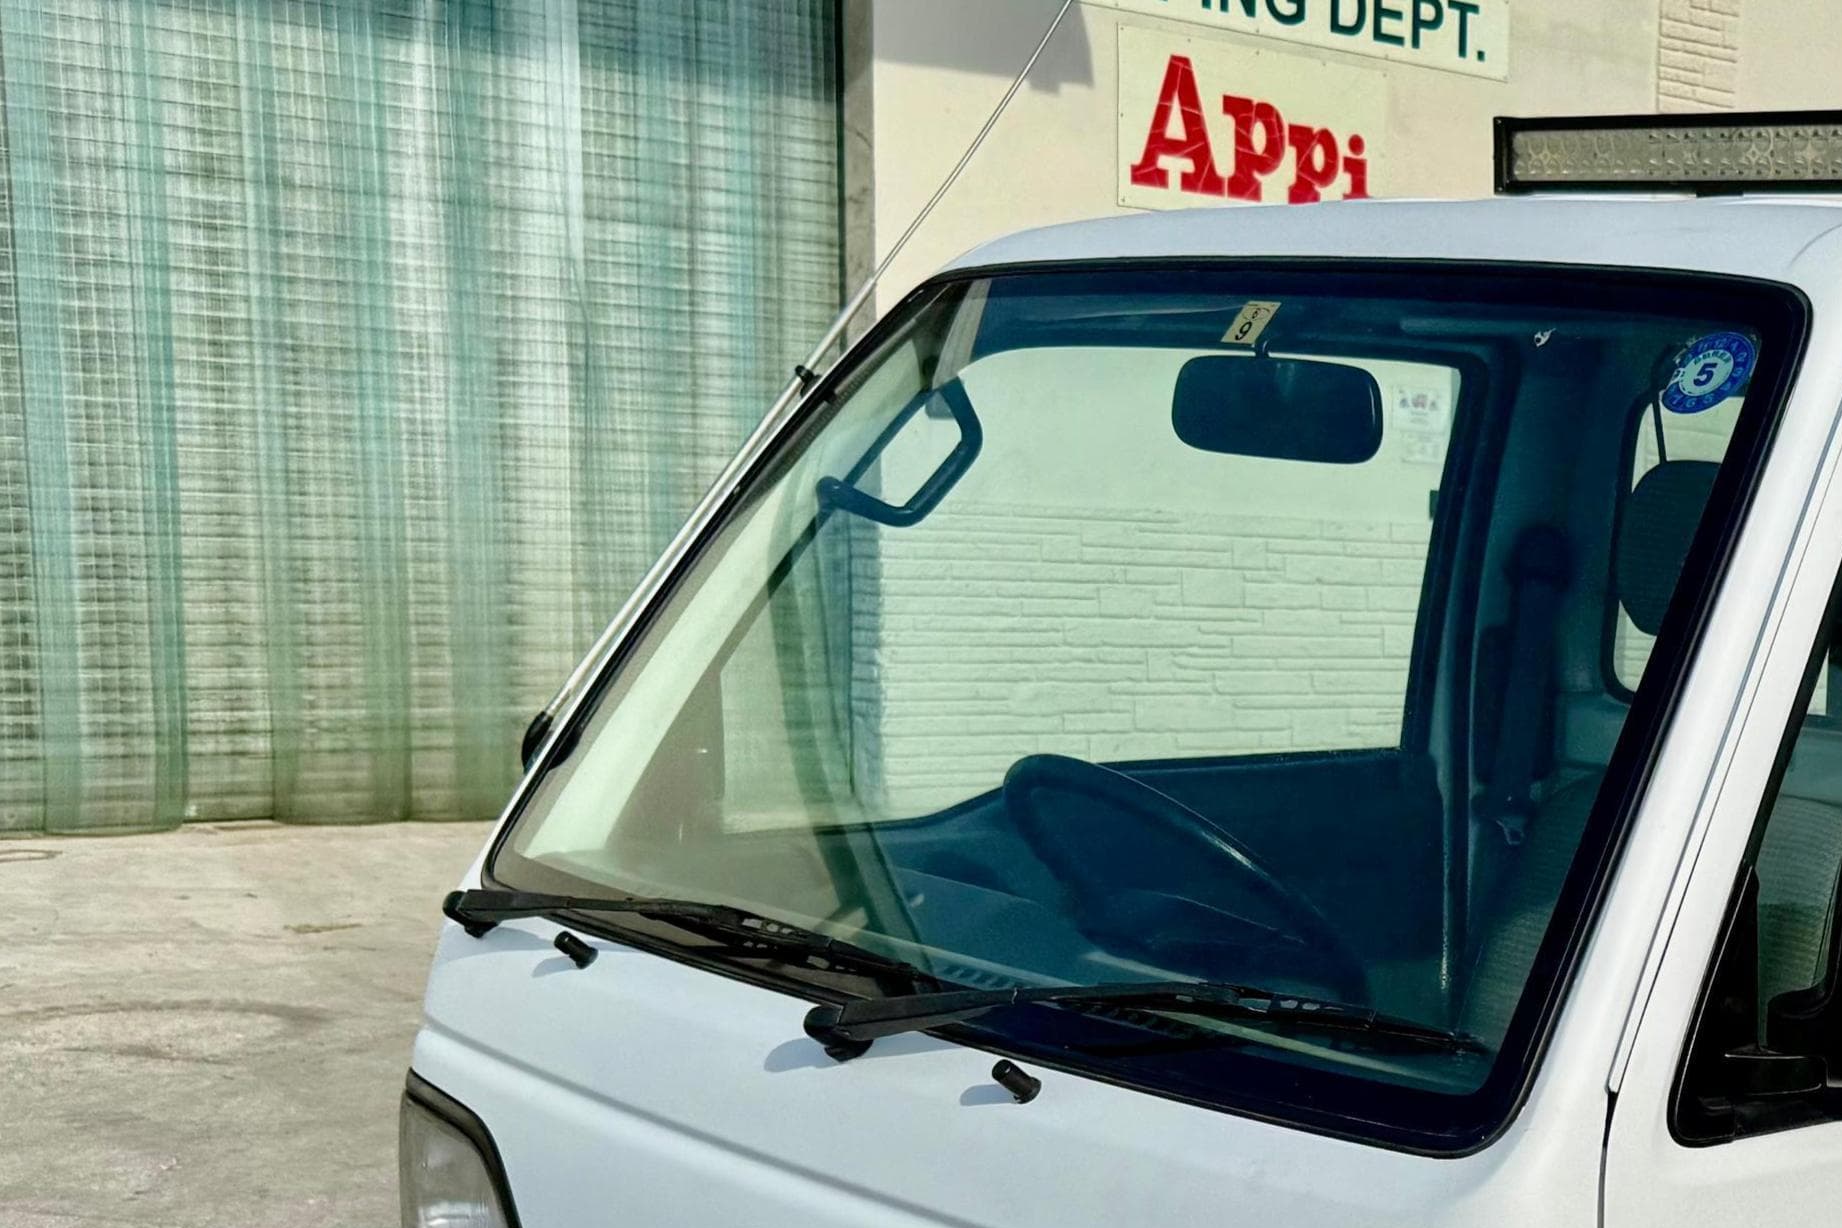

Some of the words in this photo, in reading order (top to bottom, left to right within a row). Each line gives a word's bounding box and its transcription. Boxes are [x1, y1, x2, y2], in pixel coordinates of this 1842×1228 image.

[1329, 0, 1486, 62] DEPT.
[1234, 321, 1253, 341] 9
[1693, 362, 1719, 387] 5
